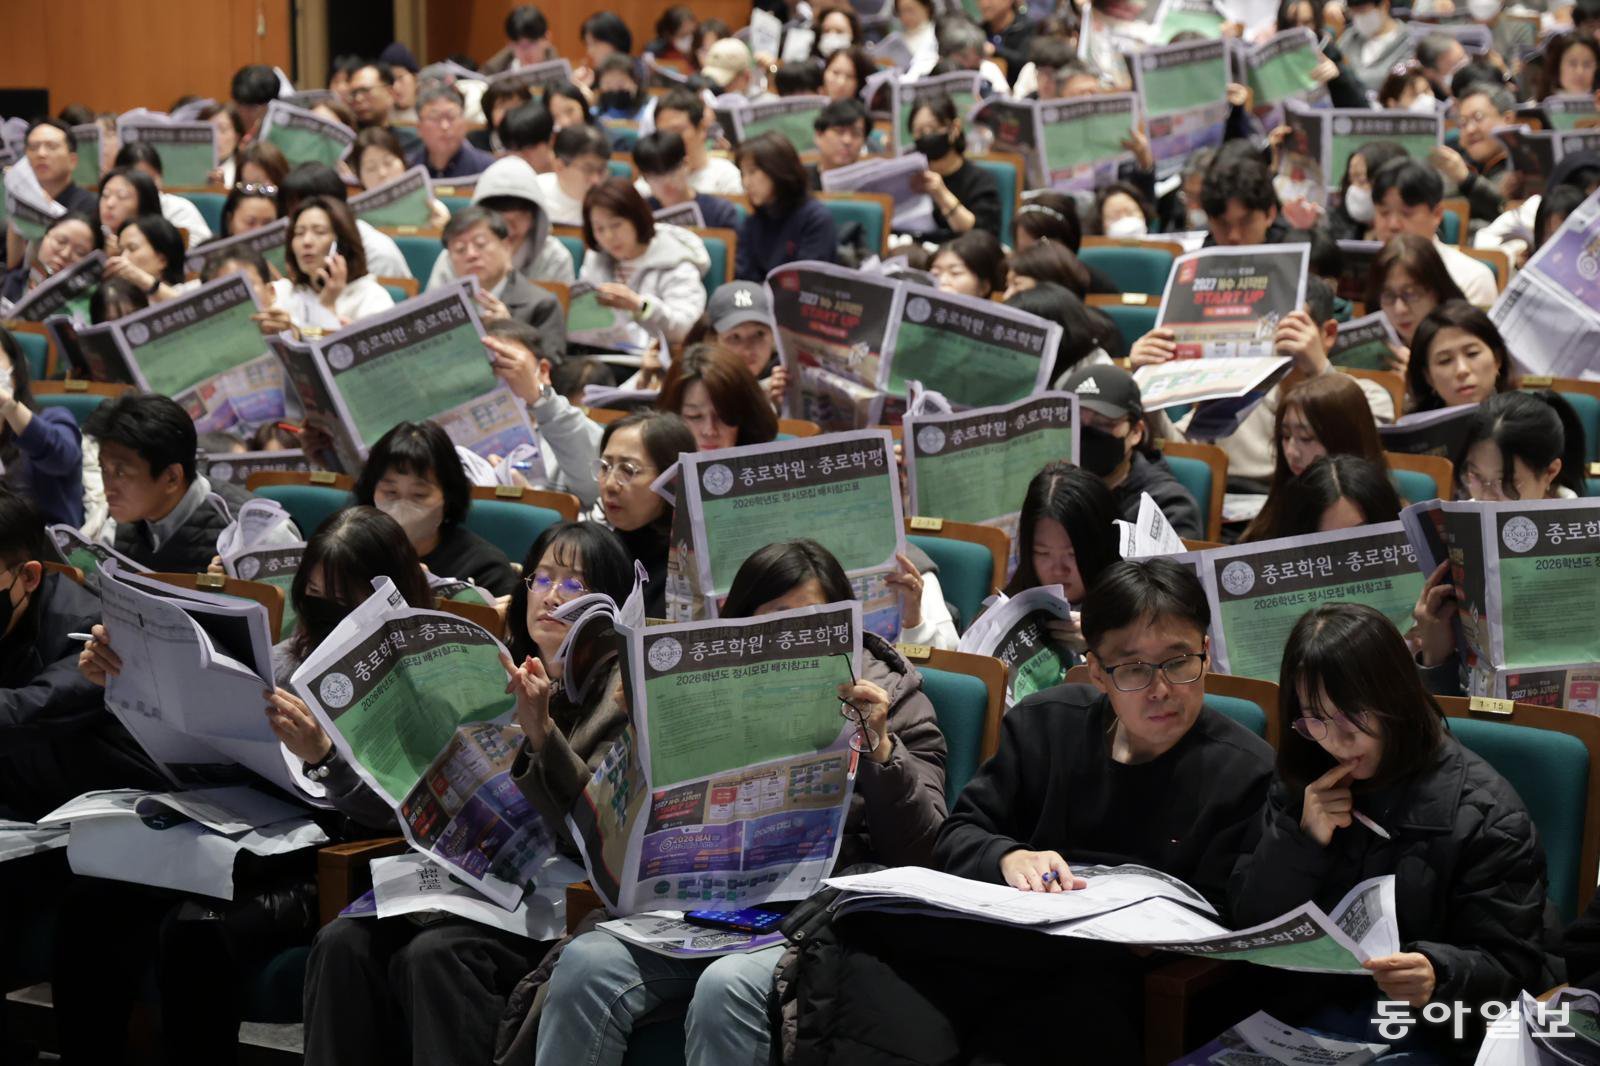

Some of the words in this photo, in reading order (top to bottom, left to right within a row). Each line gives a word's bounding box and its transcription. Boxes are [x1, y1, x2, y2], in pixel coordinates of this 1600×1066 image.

[1192, 278, 1217, 291] 2027
[1244, 291, 1265, 305] UP
[357, 326, 408, 355] 종로학원
[414, 302, 466, 335] 종로학평
[951, 421, 1007, 446] 종로학원
[1015, 406, 1069, 429] 종로학평
[739, 461, 806, 487] 종로학원
[817, 448, 883, 475] 종로학평
[732, 494, 780, 510] 2026학년도
[781, 488, 816, 503] 정시모집
[1260, 555, 1334, 584] 종로학원
[1536, 557, 1592, 571] 2026학년도
[1254, 594, 1307, 611] 2026학년도
[1308, 587, 1345, 603] 정시모집
[353, 629, 408, 682] 종로학원
[689, 635, 764, 662] 종로학원
[776, 623, 849, 651] 종로학평
[676, 669, 730, 687] 2026학년도
[732, 662, 770, 680] 정시모집
[771, 658, 820, 674] 배치참고표
